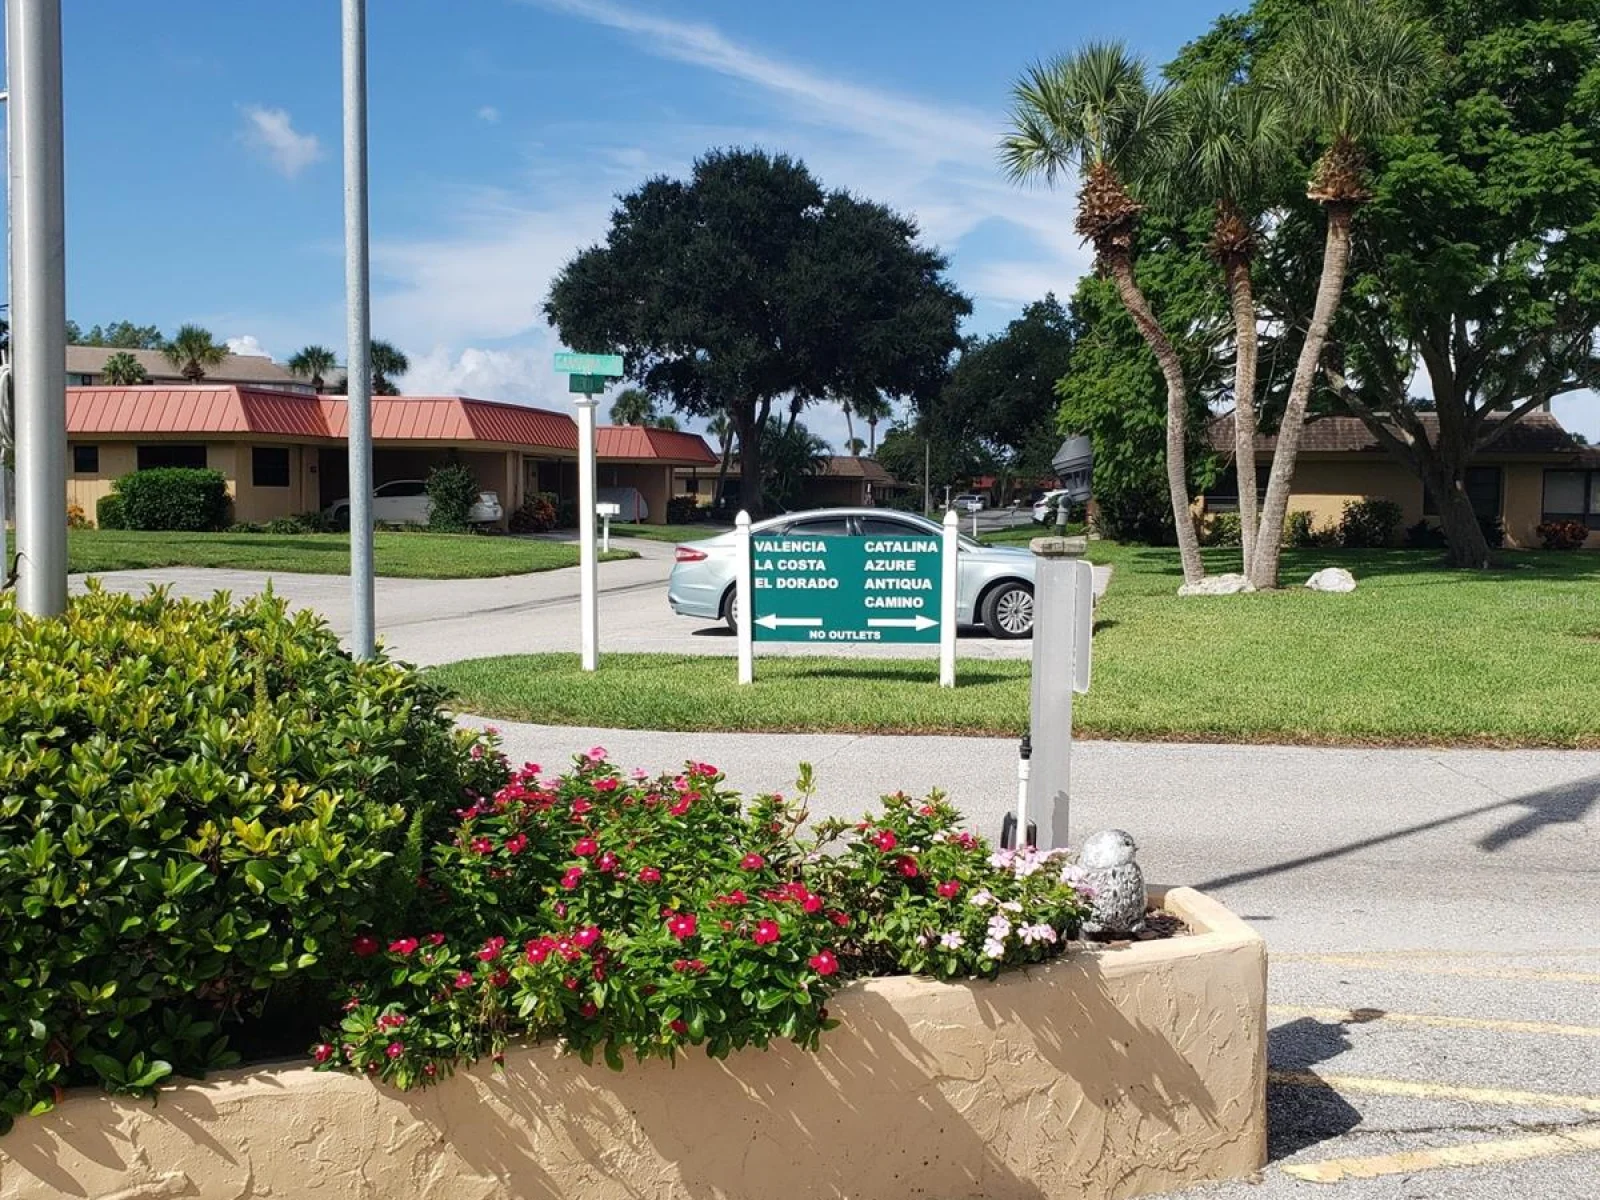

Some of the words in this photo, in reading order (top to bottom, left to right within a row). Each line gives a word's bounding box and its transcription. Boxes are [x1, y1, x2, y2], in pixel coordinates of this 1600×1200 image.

[754, 541, 827, 553] VALENCIA
[864, 541, 938, 553] CATALINA
[754, 560, 774, 571] LA
[777, 560, 826, 571] COSTA
[864, 560, 917, 571] AZURE
[754, 578, 772, 589] EL
[776, 578, 839, 589] DORADO
[864, 597, 924, 609] CAMINO
[809, 630, 827, 640] NO
[828, 630, 881, 640] OUTLETS
